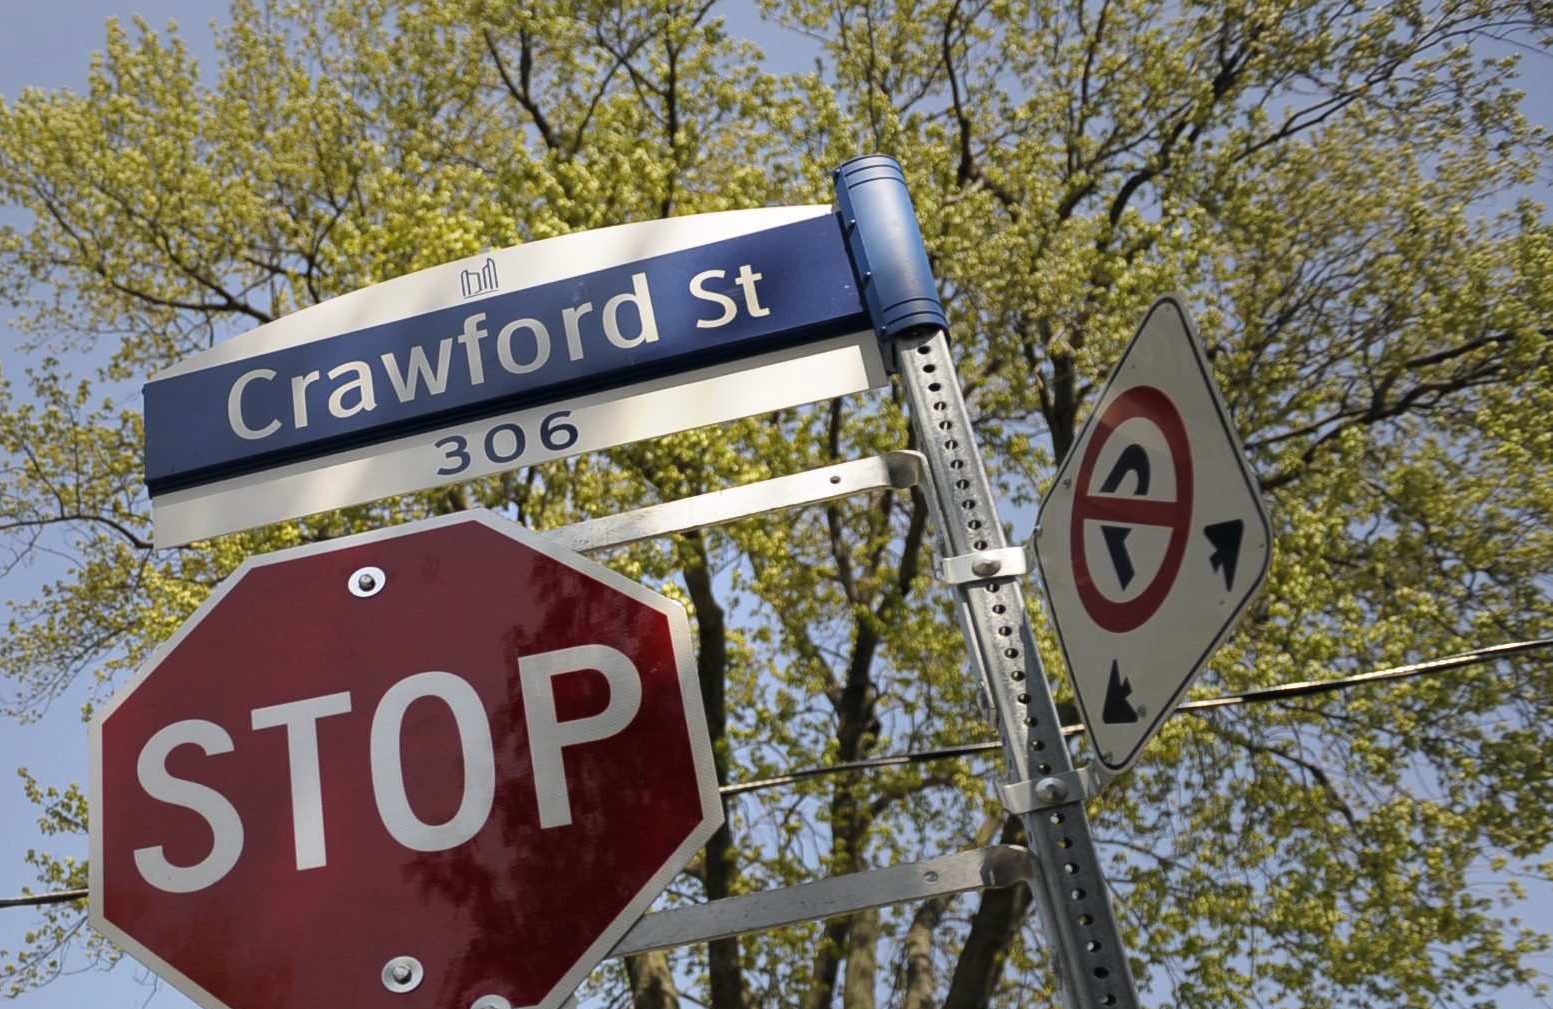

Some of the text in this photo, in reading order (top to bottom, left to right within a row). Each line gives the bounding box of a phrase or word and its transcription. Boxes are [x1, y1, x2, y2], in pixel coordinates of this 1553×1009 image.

[226, 264, 770, 440] Crawford St
[435, 410, 580, 476] 306
[133, 643, 643, 894] STOP
